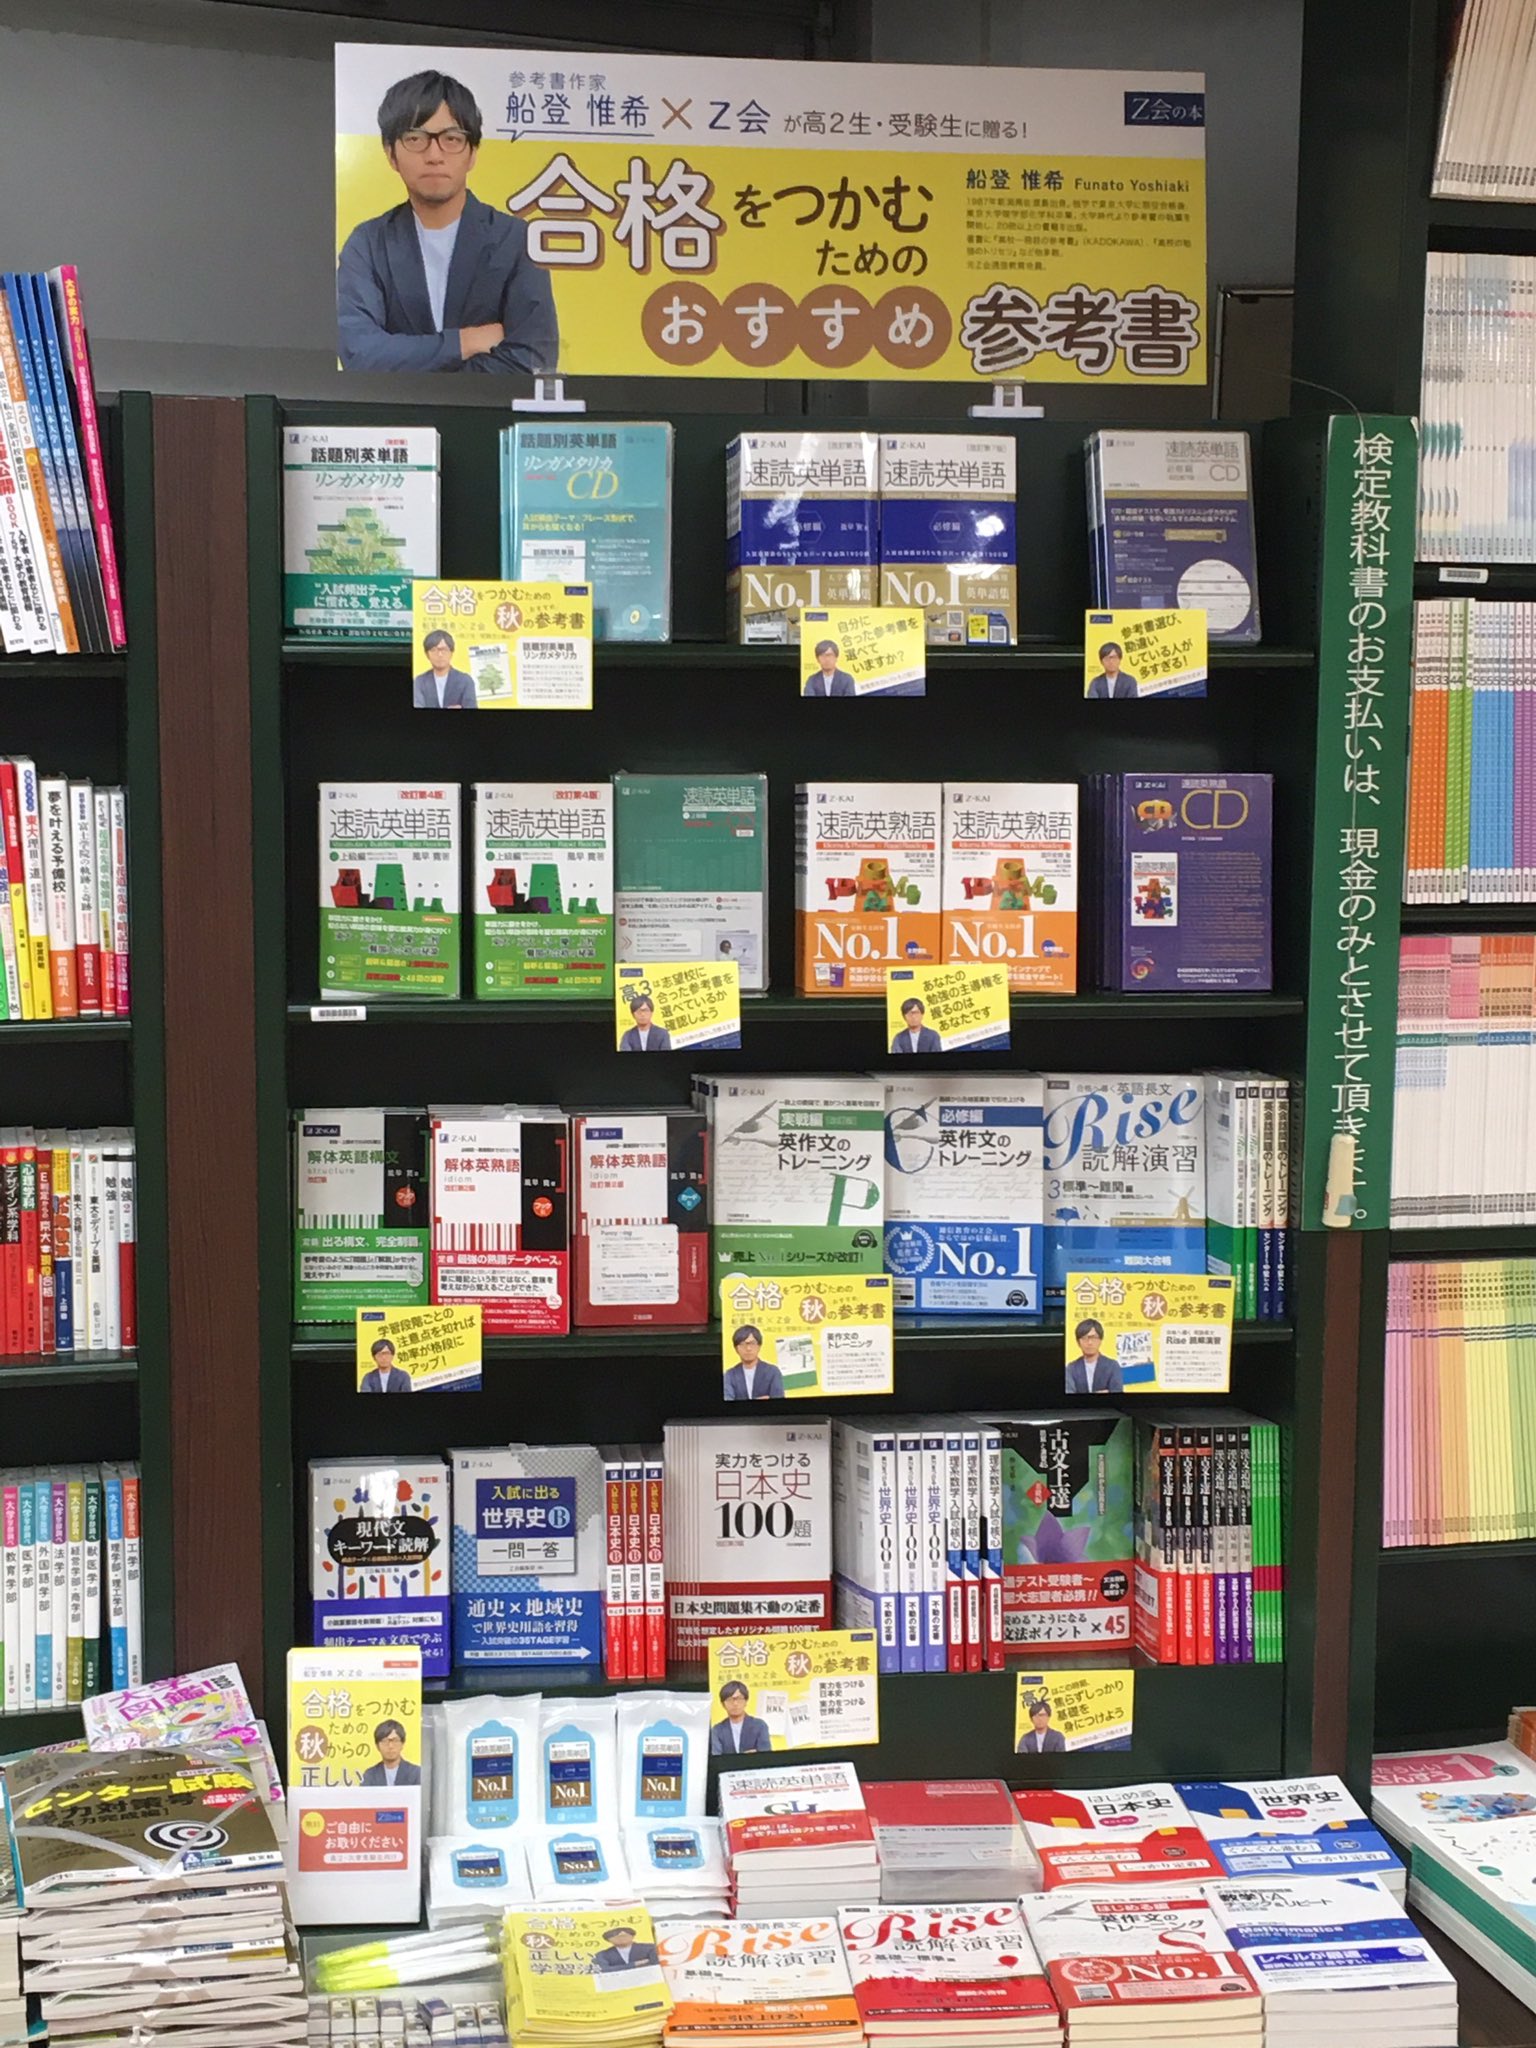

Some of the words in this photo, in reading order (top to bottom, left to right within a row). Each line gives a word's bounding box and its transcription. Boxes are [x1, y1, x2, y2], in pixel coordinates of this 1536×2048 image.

[508, 71, 607, 91] 参考書作家
[505, 92, 571, 126] 船登
[586, 94, 650, 128] 惟希
[1131, 96, 1205, 121] Z会の本
[966, 169, 1011, 191] 船登
[1021, 170, 1064, 191] 惟希
[1074, 178, 1125, 191] Funato
[1130, 179, 1190, 193] Yoshiaki
[816, 240, 929, 277] ための
[960, 284, 1199, 375] 参考書
[520, 432, 617, 449] 話題別英単語
[311, 447, 409, 464] 話題別英単語
[522, 455, 613, 473] リンガメタリカ
[315, 473, 406, 491] リンガメタリカ
[745, 458, 867, 488] 速読英単語
[885, 459, 1006, 489] 速読英単語
[1209, 464, 1241, 482] CD
[567, 470, 620, 501] CD
[744, 568, 825, 608] No.1
[884, 570, 963, 606] No.1
[837, 615, 872, 634] 自分に
[1343, 431, 1395, 806] 検定教科書のお支払いは、
[841, 618, 919, 650] 合った参考書を
[1125, 633, 1159, 655] 勘違い
[522, 641, 574, 652] 話題別英単語
[522, 650, 578, 660] リンガメタリカ
[844, 641, 878, 663] 選べて
[1129, 638, 1193, 668] している人が
[683, 786, 757, 806] 速読英単語
[1181, 789, 1249, 830] CD
[330, 808, 451, 840] 速読英単語
[487, 808, 606, 840] 速読英単語
[816, 811, 936, 841] 速読英熟語
[952, 811, 1072, 841] 速読英熟語
[47, 790, 67, 894] 夢を叶える予備校
[340, 852, 366, 861] 上級編
[495, 852, 521, 861] 上級編
[814, 916, 903, 961] No.1
[950, 914, 1039, 959] No.1
[656, 972, 734, 1004] 合った参考書を
[922, 970, 966, 991] あなたの
[926, 974, 1003, 1006] 勉強の主導権を
[620, 980, 653, 1004] 高3
[661, 989, 727, 1018] 選べているか
[930, 997, 975, 1020] 握るのは
[664, 1007, 719, 1031] 確認しよう
[938, 1006, 992, 1032] あなたです
[941, 1109, 984, 1124] 必修編
[939, 1129, 1011, 1149] 英作文の
[1043, 1088, 1206, 1171] Rise
[777, 1133, 850, 1152] 英作文の
[307, 1150, 399, 1165] 解体英語構文
[444, 1157, 521, 1173] 解体英熟語
[590, 1153, 667, 1169] 解体英熟語
[777, 1153, 872, 1172] トレーニング
[939, 1150, 1032, 1168] トレーニング
[1081, 1144, 1197, 1173] 読解演習
[307, 1167, 356, 1176] structure
[444, 1175, 473, 1183] idiom
[20, 1163, 36, 1210] 心理学科
[1047, 1179, 1061, 1199] 3
[935, 1226, 1038, 1277] No.1
[377, 1307, 454, 1338] 学習段階ごとの
[397, 1315, 476, 1349] 注意点を知れば
[827, 1332, 858, 1342] 英作文の
[1166, 1336, 1188, 1346] Rise
[397, 1334, 465, 1364] 効率が格段に
[715, 1452, 812, 1469] 実力をつける
[1049, 1428, 1071, 1510] 古文上達
[490, 1485, 561, 1501] 入試に出る
[715, 1469, 813, 1501] 日本史
[355, 1519, 406, 1538] 現代文
[482, 1506, 547, 1530] 世界史
[714, 1501, 812, 1540] 100題
[609, 1514, 621, 1550] 日本史
[333, 1536, 429, 1557] キーワード読解
[491, 1541, 561, 1560] 一問一答
[53, 1548, 66, 1587] 法学部
[86, 1546, 99, 1598] 獣医学部
[127, 1543, 140, 1580] 工学部
[38, 1546, 50, 1613] 外国語学部
[467, 1597, 584, 1619] 通史×地域史
[673, 1600, 822, 1615] 日本史問題集不動の定番
[1020, 1686, 1050, 1708] 高2
[1053, 1680, 1125, 1708] 焦らずしっかり
[1056, 1705, 1089, 1722] 基礎を
[1064, 1708, 1125, 1733] 身につけよう
[328, 1721, 368, 1736] ための
[300, 1766, 362, 1787] 正しい
[1444, 1754, 1486, 1778] 1
[476, 1775, 507, 1794] No.1
[555, 1782, 586, 1799] No.1
[645, 1776, 677, 1792] No.1
[729, 1771, 849, 1791] 速読英単語
[1252, 1782, 1322, 1796] はじめる
[1087, 1789, 1156, 1804] はじめる
[1093, 1798, 1174, 1816] 日本史
[1259, 1791, 1343, 1807] 世界史
[325, 1821, 372, 1834] ご自由に
[325, 1836, 404, 1849] お取りください
[464, 1867, 495, 1877] No.1
[562, 1860, 595, 1870] No.1
[843, 1907, 1026, 1952] Rise
[1100, 1913, 1180, 1924] 英作文の
[1101, 1919, 1205, 1932] トレーニング
[658, 1922, 836, 1967] Rise
[894, 1935, 1023, 1953] 読解演習
[530, 1950, 598, 1962] 正しい
[705, 1949, 837, 1969] 読解演習
[1126, 1953, 1244, 1982] No.1
